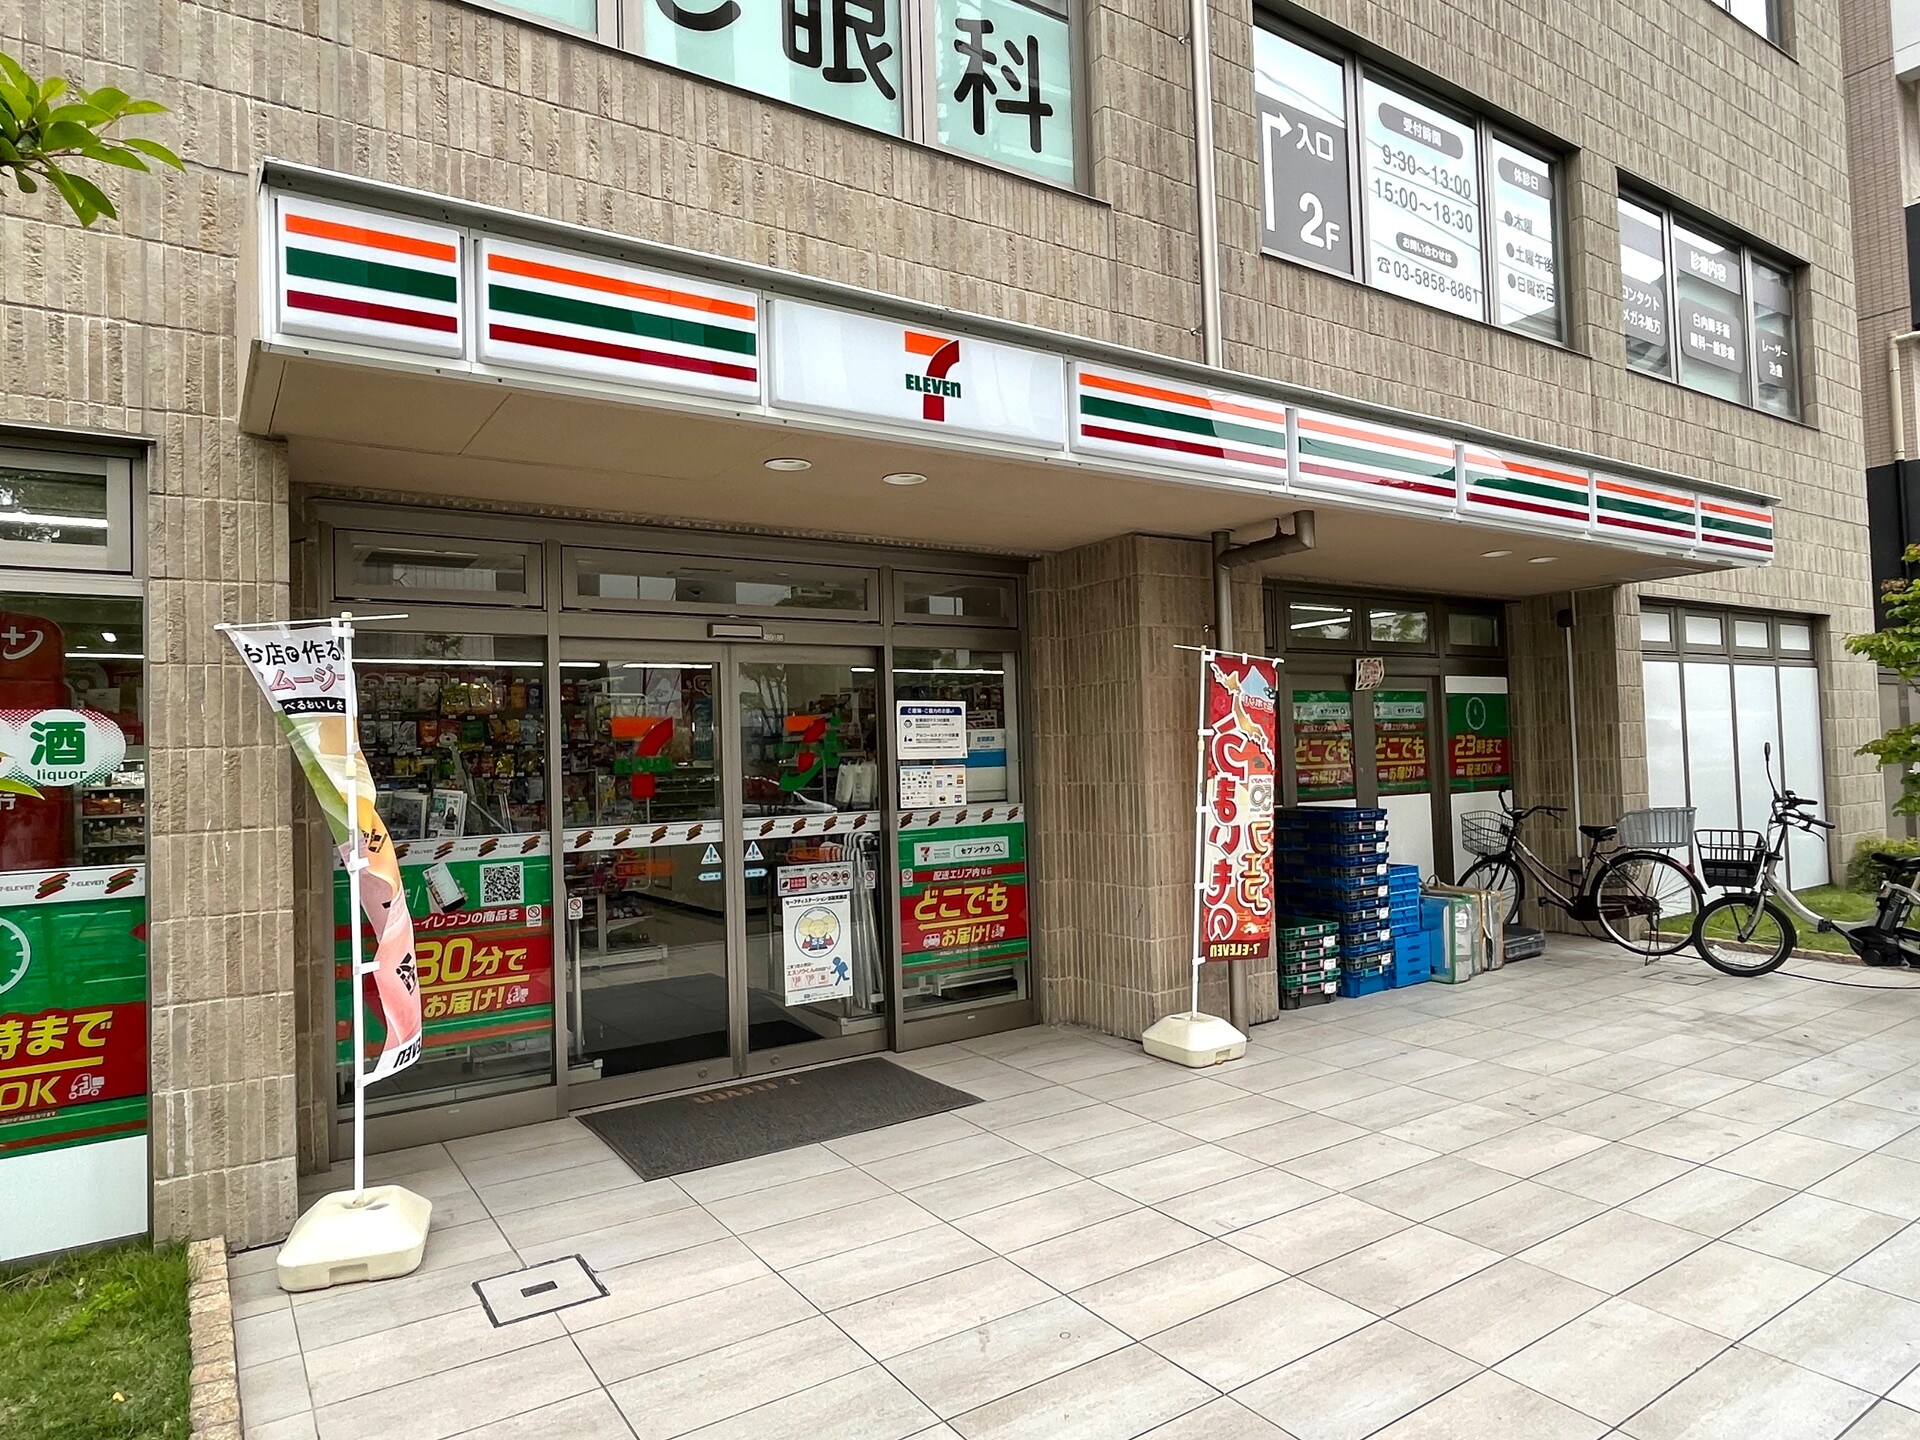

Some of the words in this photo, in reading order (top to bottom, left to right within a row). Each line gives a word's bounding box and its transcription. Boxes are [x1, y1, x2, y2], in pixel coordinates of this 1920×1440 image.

[1295, 122, 1334, 162] 入口
[1402, 116, 1442, 147] 受付時間
[1514, 167, 1539, 191] 休診日
[1298, 192, 1341, 250] 2F
[1515, 245, 1555, 275] 土曜午後
[1517, 276, 1555, 304] 日曜祝日
[1621, 284, 1661, 311] コンタクト
[1622, 308, 1661, 335] メガネ処方
[30, 721, 86, 766] 酒
[1375, 737, 1425, 759] どこでも
[1454, 734, 1502, 756] 23時まで
[37, 768, 87, 781] liquor
[960, 846, 991, 855] セブンナウ
[914, 883, 1009, 920] どこでも
